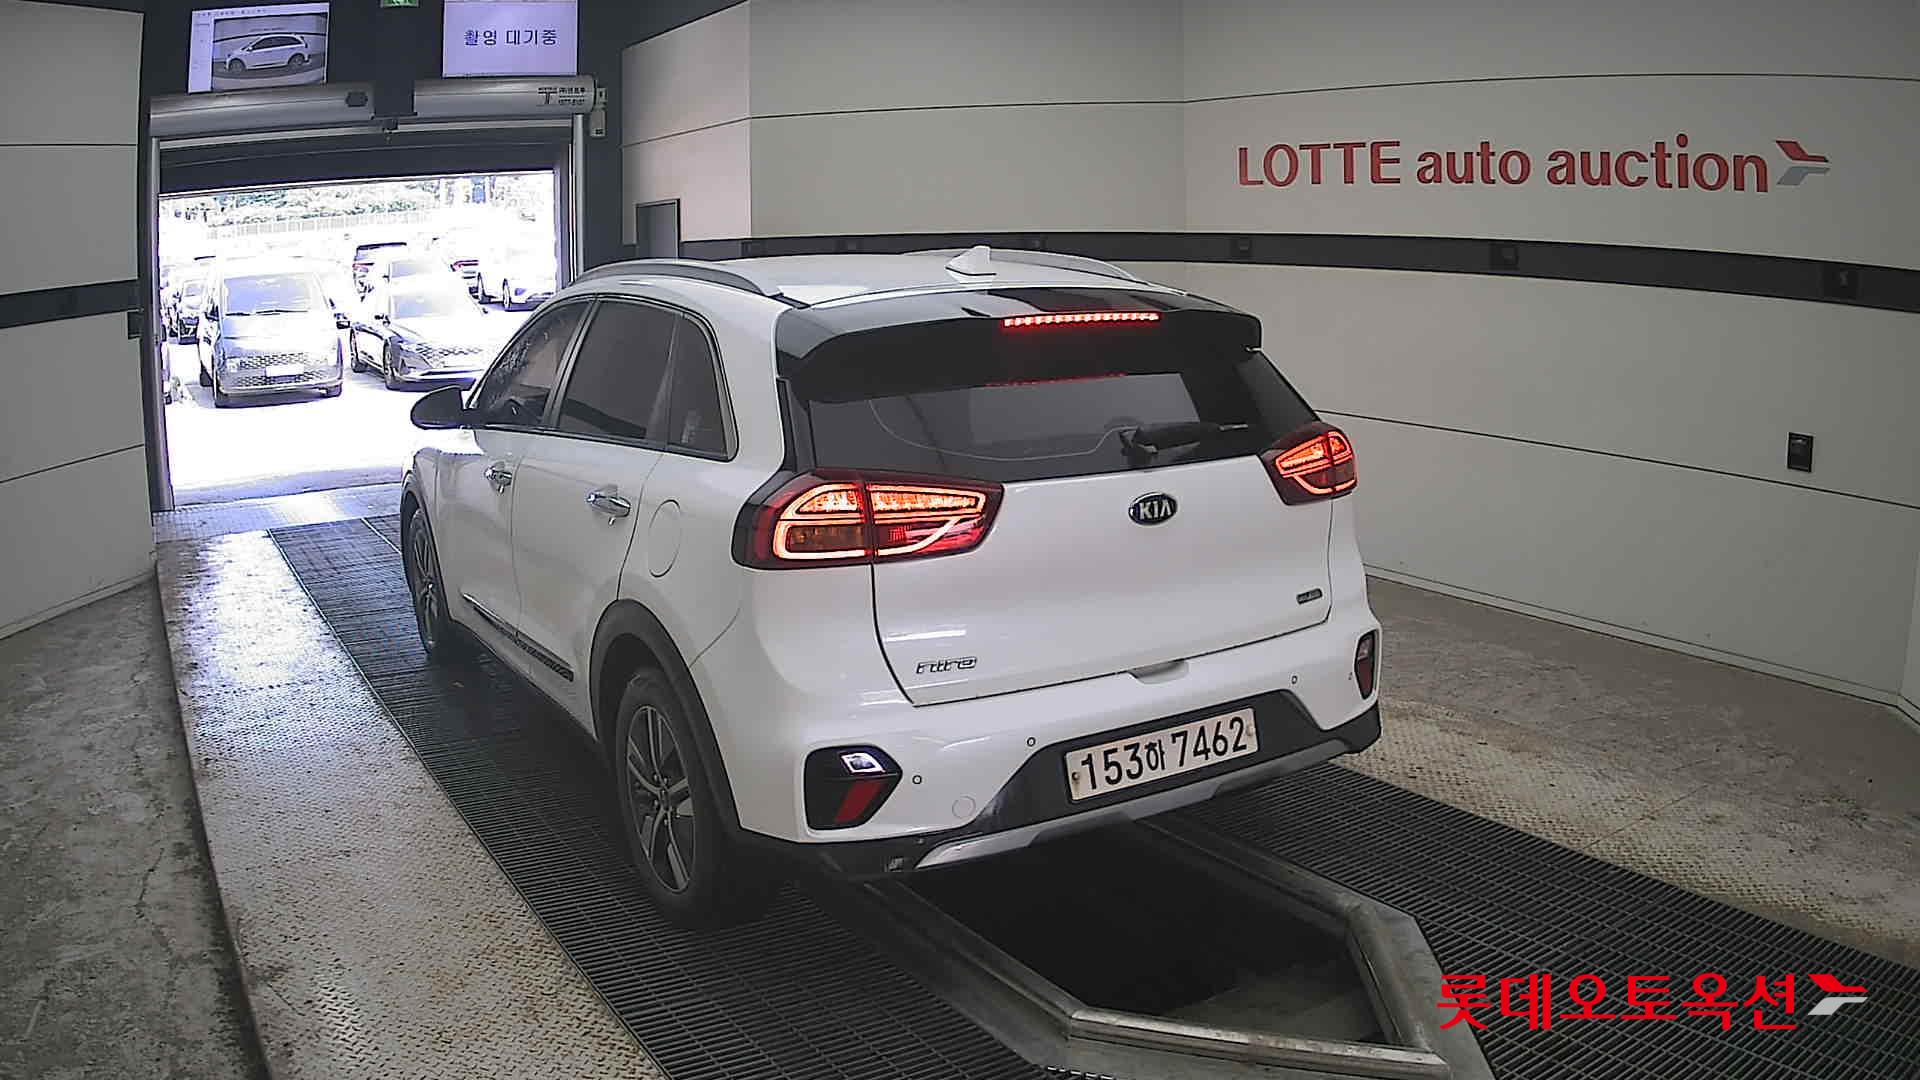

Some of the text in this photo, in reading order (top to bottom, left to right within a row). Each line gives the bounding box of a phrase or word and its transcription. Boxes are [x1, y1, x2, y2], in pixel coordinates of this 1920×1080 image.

[505, 29, 558, 46] 대기중
[1238, 133, 1770, 193] LOTTE auto auction
[1138, 499, 1172, 521] KIA
[1080, 716, 1248, 790] 153하 7462
